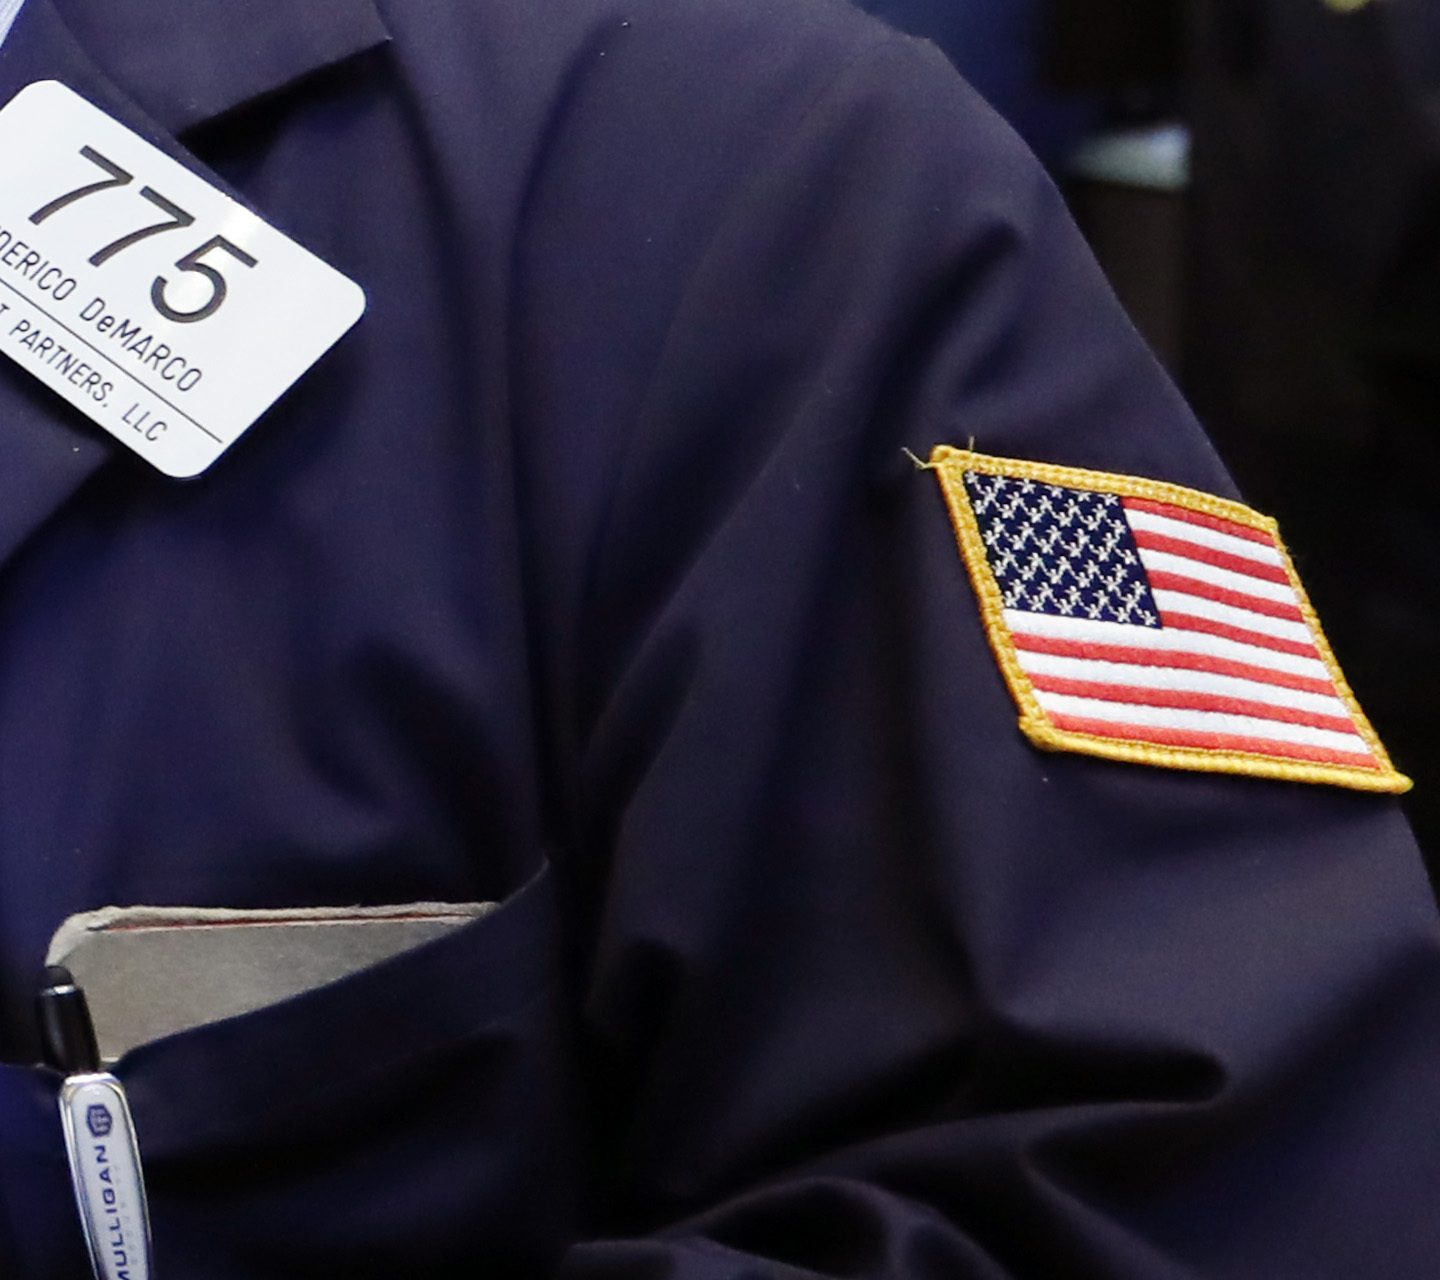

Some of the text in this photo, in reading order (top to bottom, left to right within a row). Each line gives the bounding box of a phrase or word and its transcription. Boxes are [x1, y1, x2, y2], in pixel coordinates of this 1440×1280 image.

[28, 144, 259, 324] 775
[8, 320, 114, 408] PARTNERS,
[121, 403, 167, 442] LLC
[80, 297, 203, 392] DeMARCO
